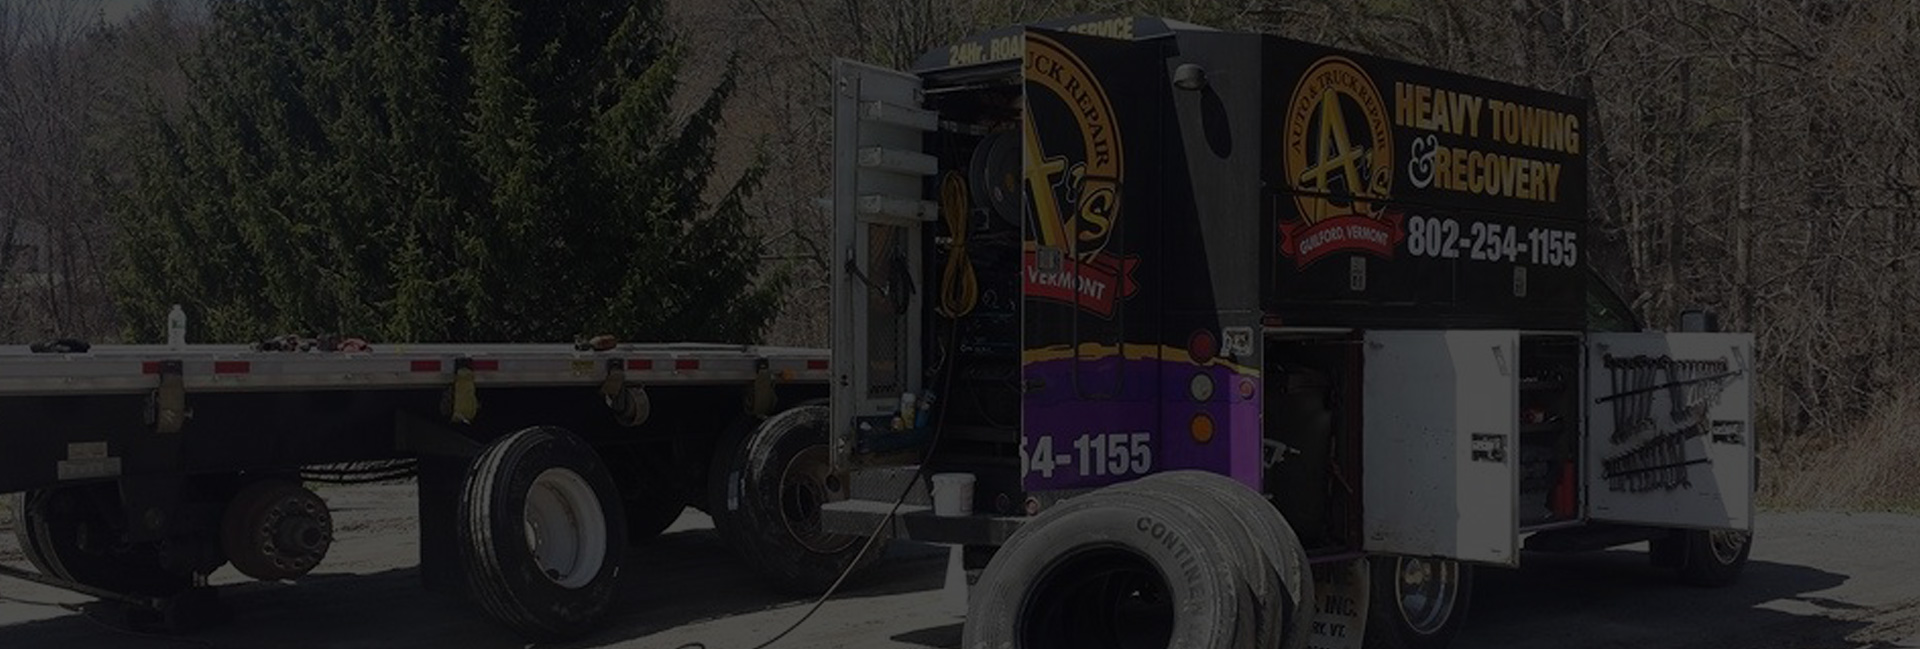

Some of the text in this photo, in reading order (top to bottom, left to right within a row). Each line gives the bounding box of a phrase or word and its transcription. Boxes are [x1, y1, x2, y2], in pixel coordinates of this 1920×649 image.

[991, 34, 1025, 60] ROA
[1064, 75, 1109, 168] REPAIR
[1292, 96, 1312, 154] AUTO
[1316, 69, 1359, 94] TRUCK
[1358, 85, 1386, 150] REPAIR
[1395, 82, 1580, 155] HEAVY TOWING
[1407, 134, 1562, 202] & RECOVERY
[1346, 225, 1389, 246] VERMONT
[1407, 215, 1577, 268] 802-254-1155
